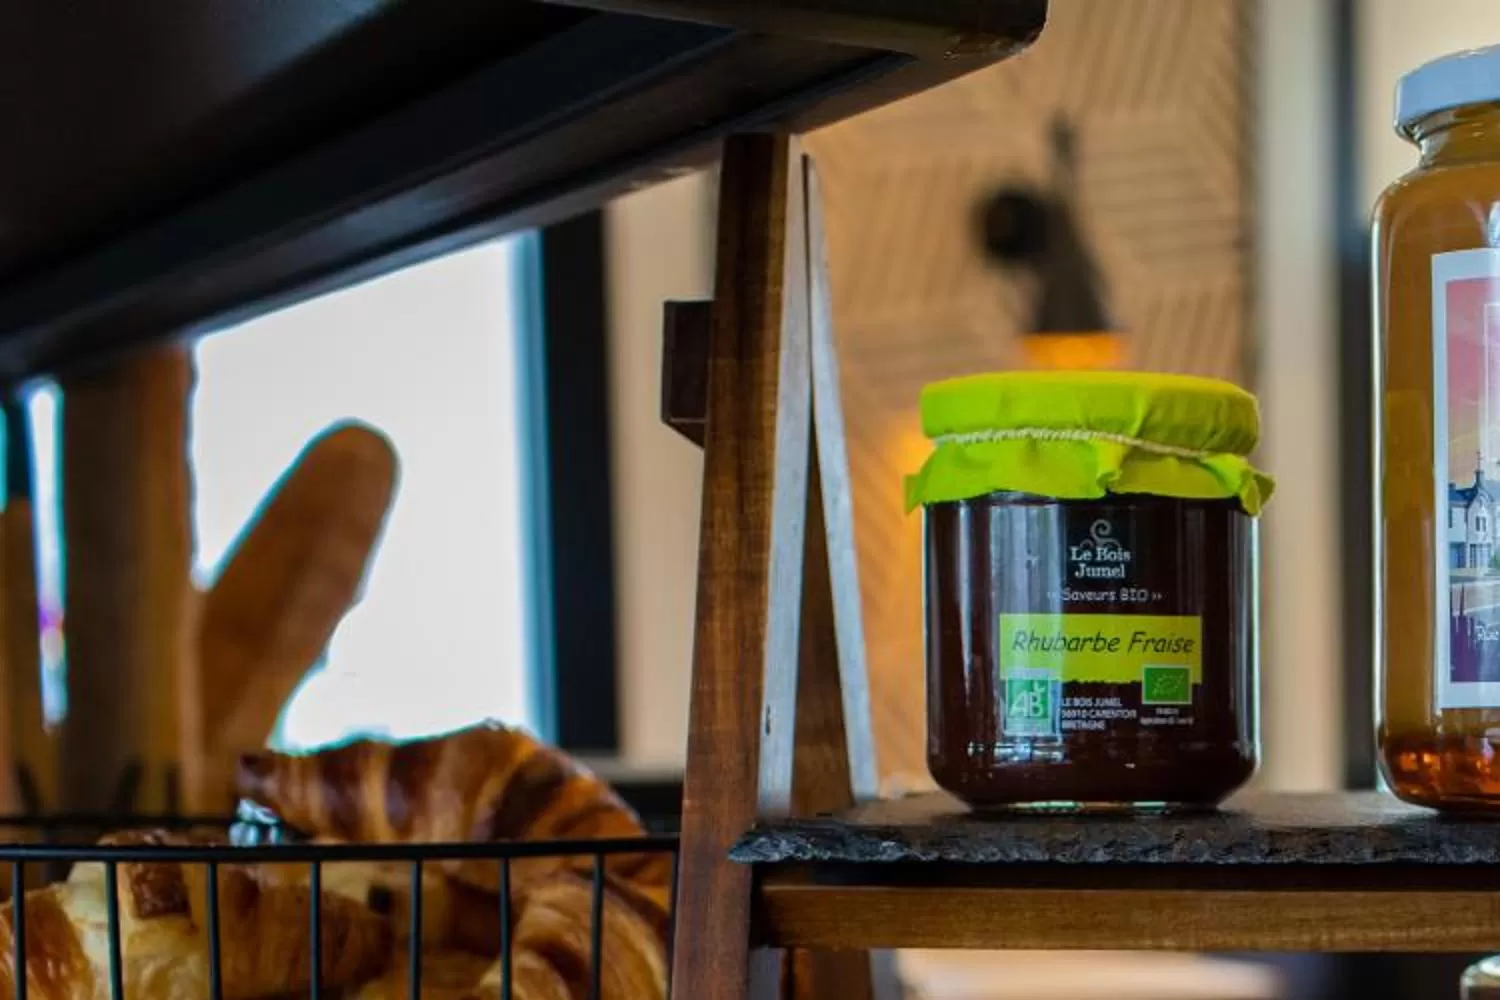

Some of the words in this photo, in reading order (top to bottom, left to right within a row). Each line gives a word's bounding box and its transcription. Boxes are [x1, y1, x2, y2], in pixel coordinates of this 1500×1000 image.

[1070, 546, 1092, 561] Le
[1096, 545, 1131, 561] Bois
[1074, 562, 1126, 579] Jumel
[1063, 586, 1117, 602] Saveurs
[1120, 587, 1149, 602] BIO
[1012, 630, 1120, 653] Rhubarbe
[1127, 631, 1196, 654] Fraise
[1008, 688, 1046, 718] AB
